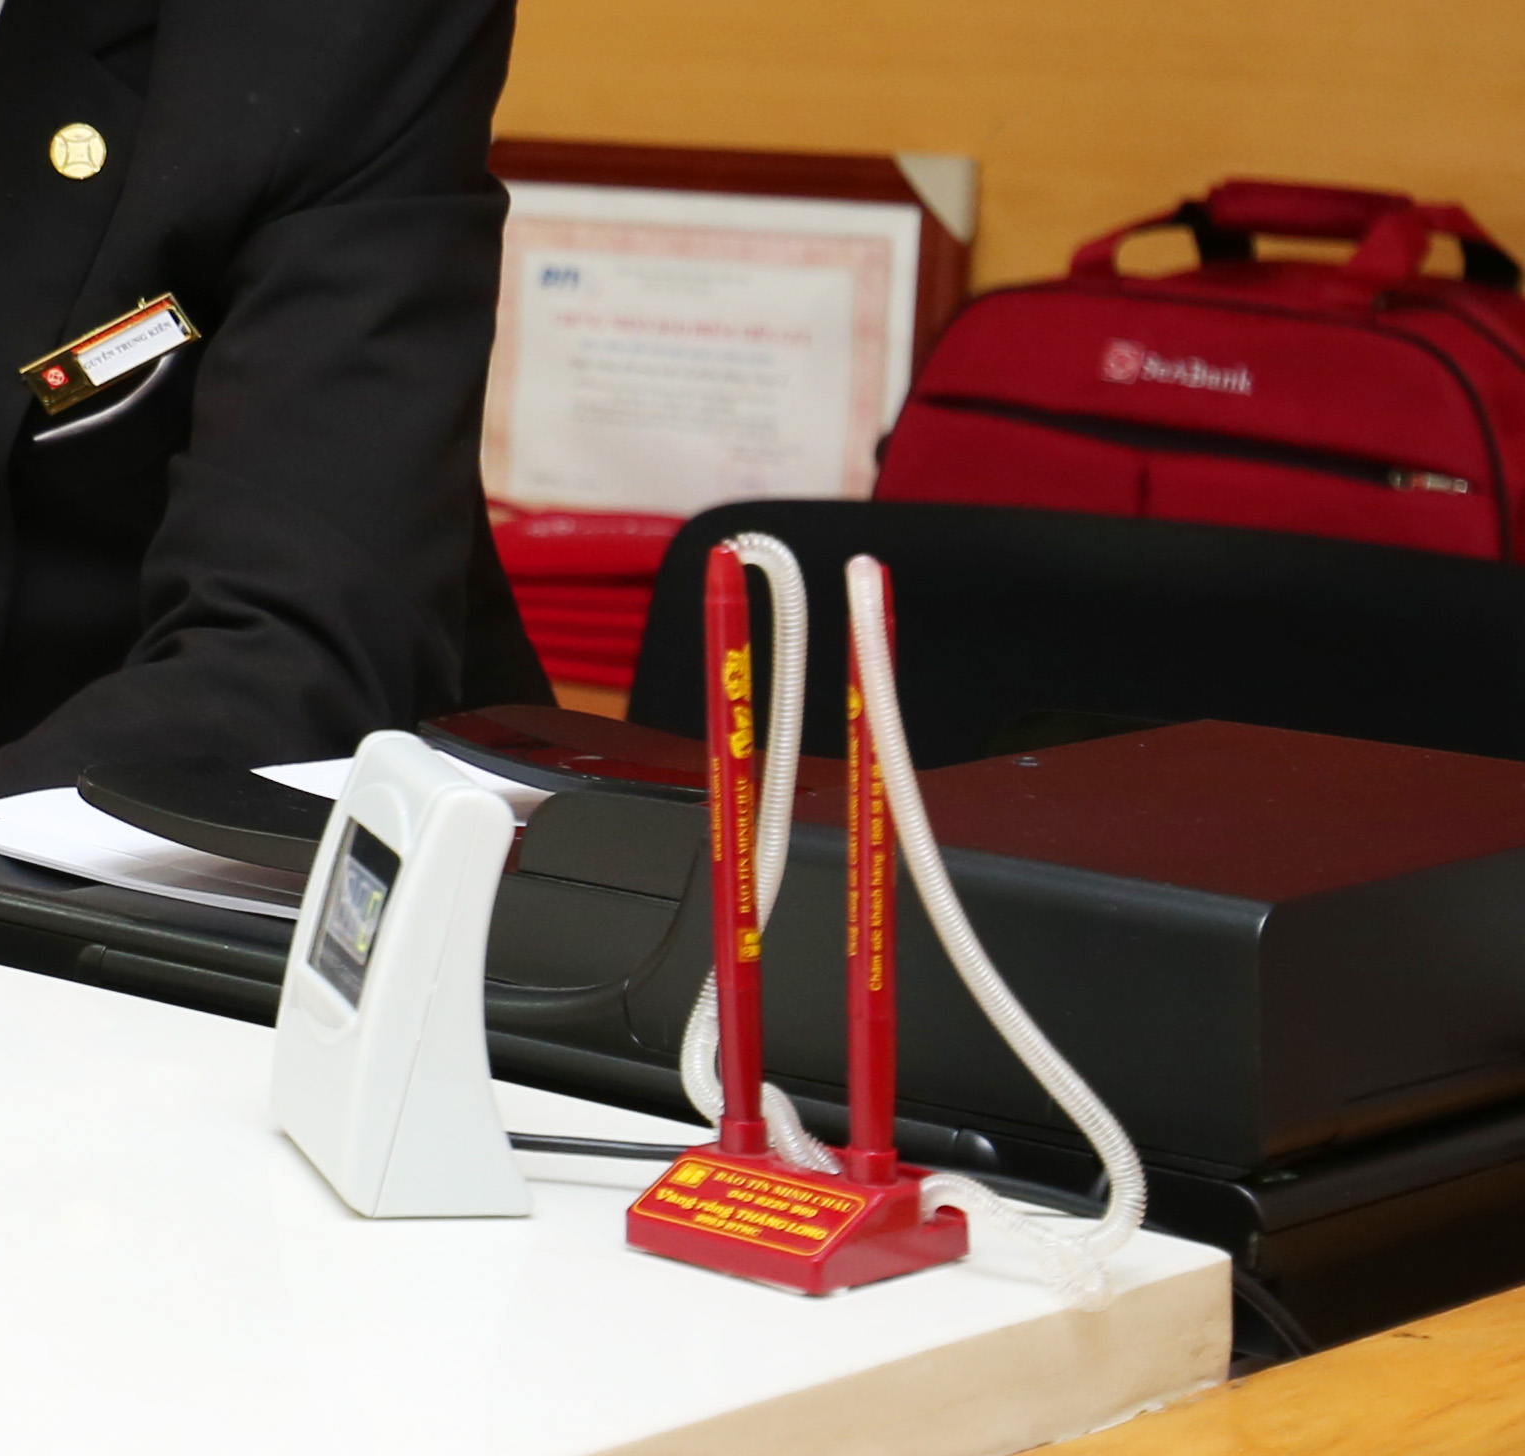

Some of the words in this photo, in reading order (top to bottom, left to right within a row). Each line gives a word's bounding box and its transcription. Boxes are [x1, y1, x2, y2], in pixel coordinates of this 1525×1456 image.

[747, 1176, 771, 1193] TÍN
[770, 1183, 812, 1202] MINH
[656, 1188, 698, 1209] Vàng
[785, 1222, 829, 1241] LONG
